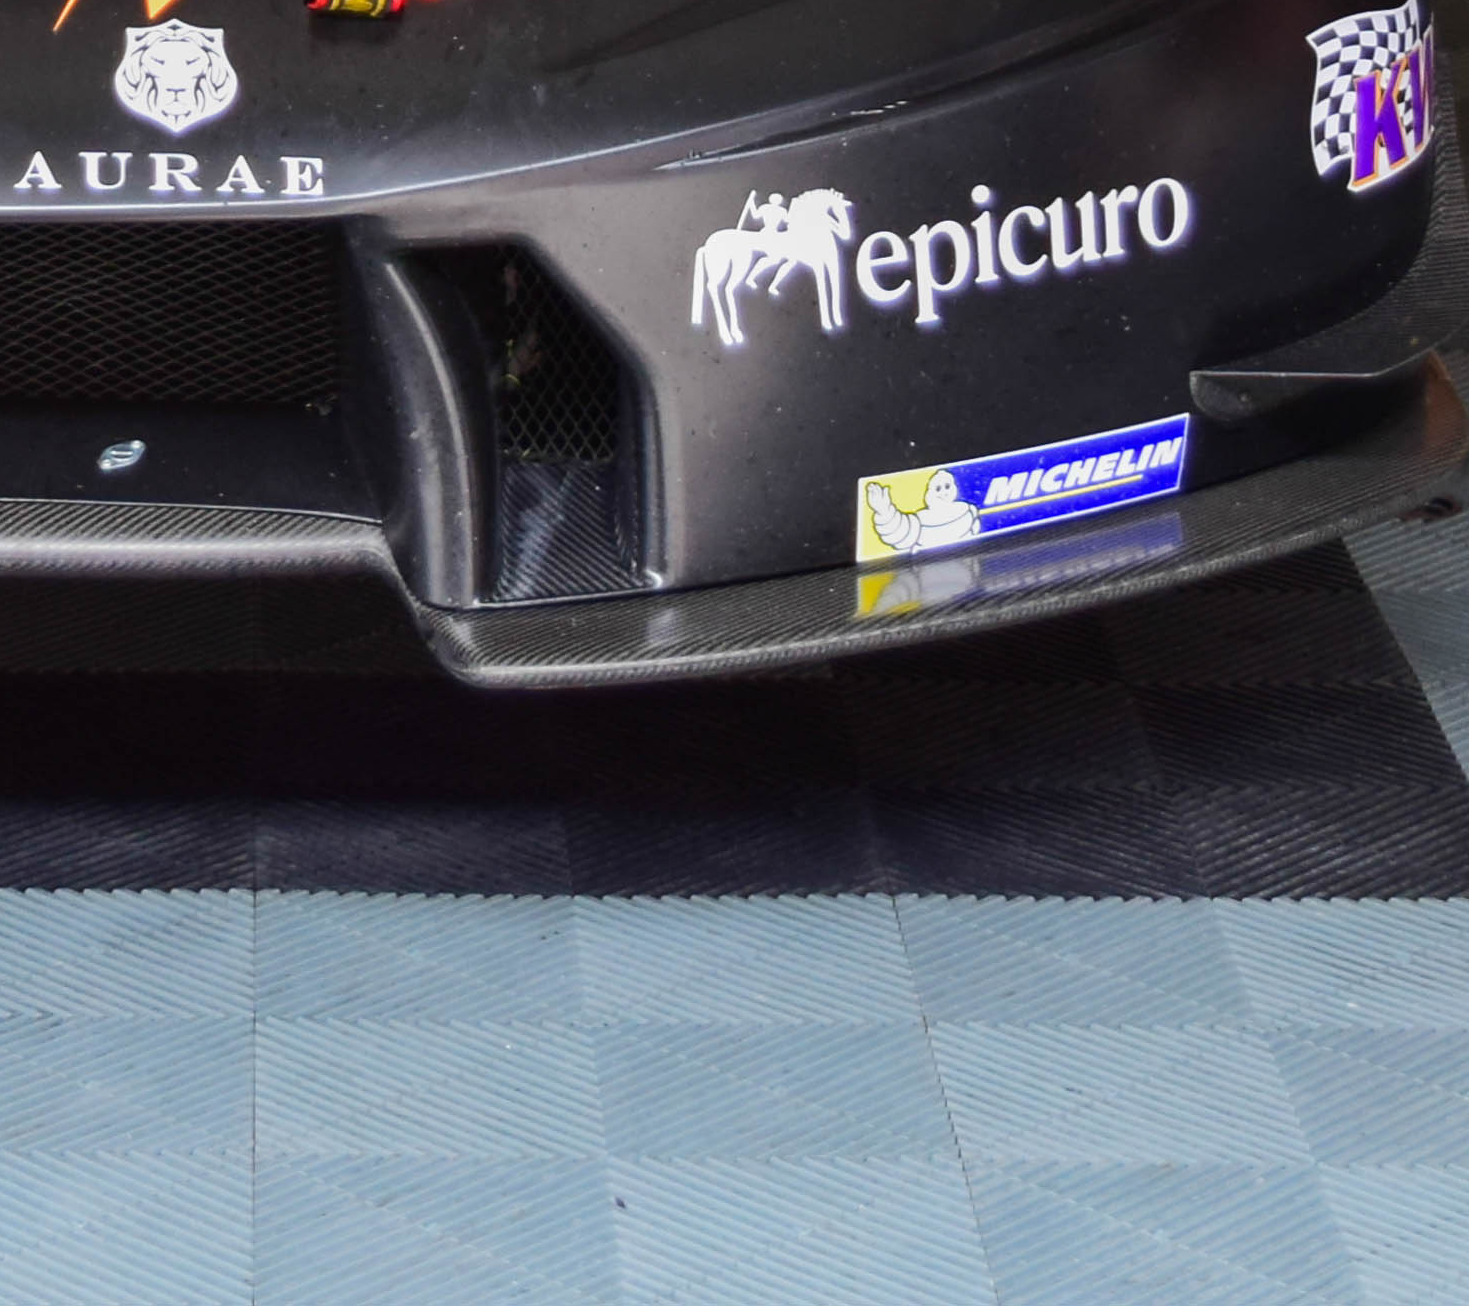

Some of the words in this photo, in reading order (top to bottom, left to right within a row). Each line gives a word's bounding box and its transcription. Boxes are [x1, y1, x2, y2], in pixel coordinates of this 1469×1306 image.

[13, 149, 325, 196] AURAE
[856, 177, 1191, 325] epicuro
[981, 435, 1184, 508] MICHELIN
